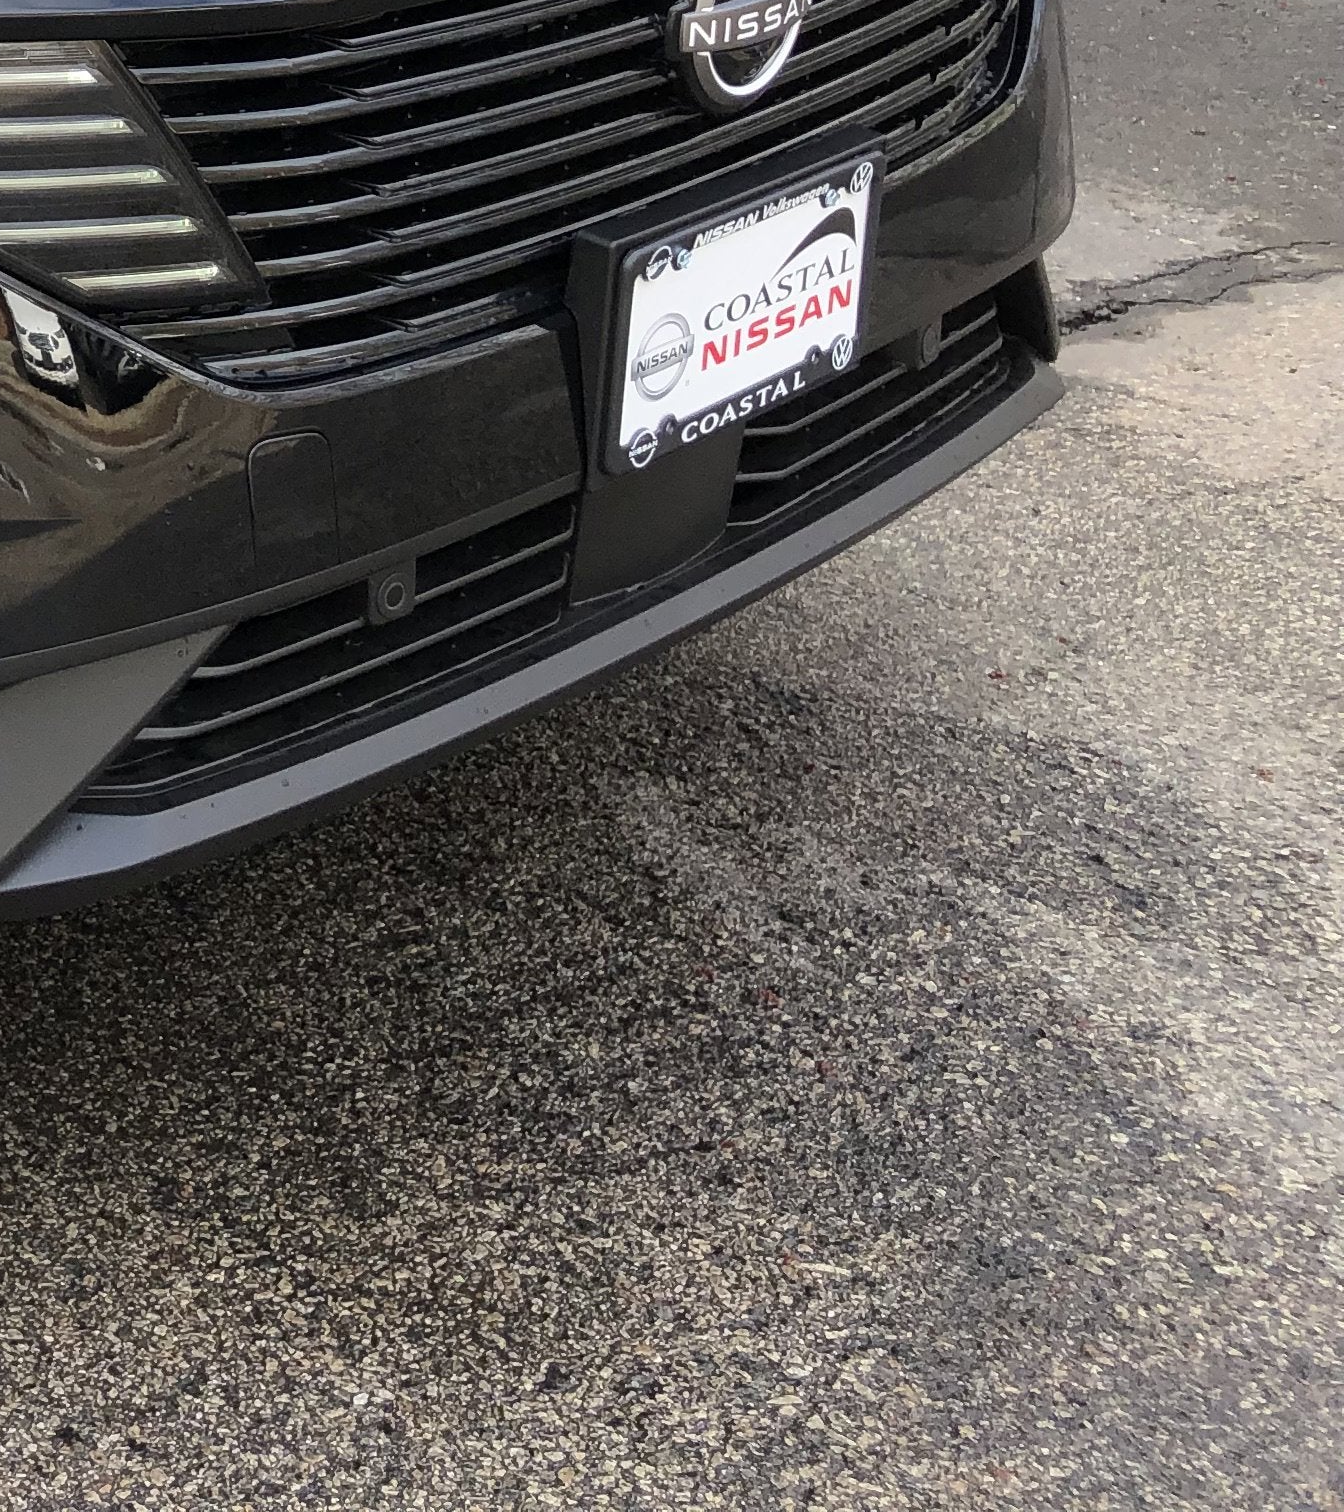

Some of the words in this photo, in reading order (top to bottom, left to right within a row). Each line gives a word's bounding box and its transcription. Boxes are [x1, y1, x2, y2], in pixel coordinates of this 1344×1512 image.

[693, 209, 759, 249] NISSAN
[701, 278, 853, 372] NISSAN
[703, 248, 855, 332] COASTAL
[636, 342, 688, 374] NISSAN
[681, 371, 806, 443] COASTAL
